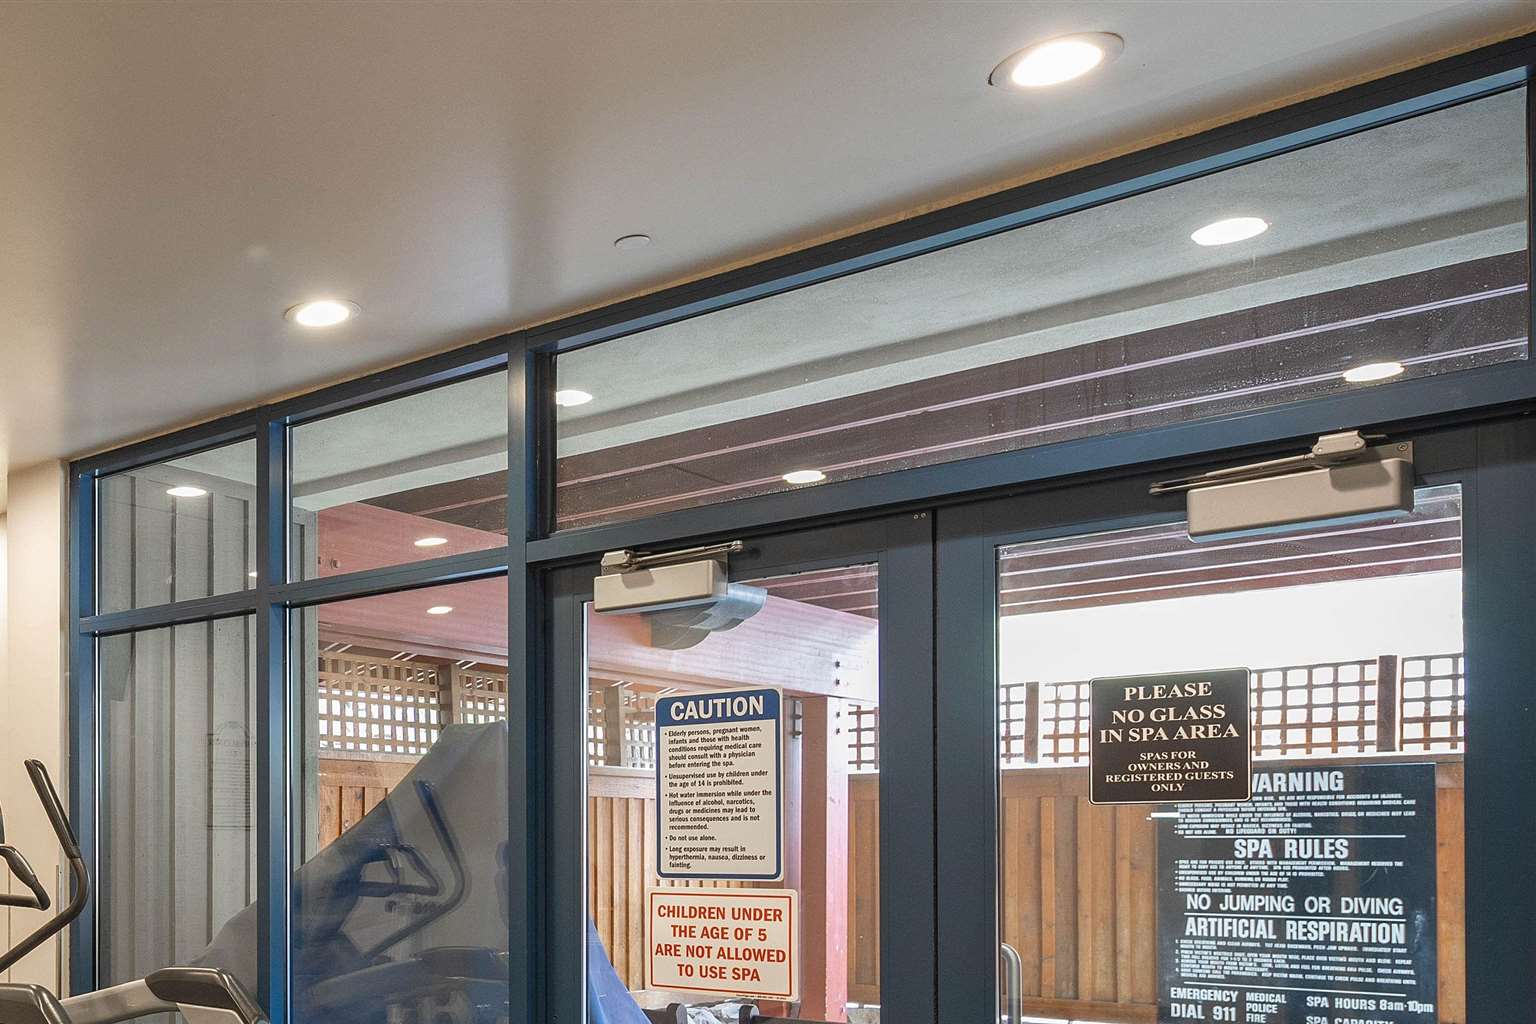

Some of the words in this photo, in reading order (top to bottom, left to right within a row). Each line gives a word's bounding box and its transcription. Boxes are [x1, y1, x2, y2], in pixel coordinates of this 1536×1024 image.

[1124, 683, 1212, 701] PLEASE
[670, 696, 763, 721] CAUTION
[1112, 709, 1144, 724] NO
[1150, 705, 1226, 722] GLASS
[668, 729, 686, 737] Elderly
[713, 726, 738, 735] pregnant
[1099, 729, 1122, 744] IN
[1129, 727, 1167, 742] SPA
[1173, 723, 1240, 740] AREA
[668, 744, 697, 752] conditions
[698, 743, 723, 752] requiring
[728, 750, 755, 759] physician
[1140, 752, 1168, 761] SPAS
[1171, 751, 1196, 759] FOR
[687, 760, 711, 769] entering
[1128, 762, 1181, 772] OWNERS
[1183, 761, 1209, 770] AND
[668, 771, 705, 781] Unsupervised
[718, 771, 725, 779] by
[1105, 773, 1182, 783] REGISTERED
[1185, 771, 1234, 780] GUESTS
[713, 778, 743, 787] prohibited.
[1151, 783, 1185, 792] ONLY
[703, 798, 725, 806] alcohol,
[669, 807, 684, 816] drugs
[669, 845, 682, 853] Long
[1234, 839, 1272, 858] SPA
[1285, 839, 1349, 858] RULES
[669, 853, 707, 862] hyperthermia,
[669, 861, 691, 869] fainting.
[1186, 894, 1211, 911] NO
[1220, 894, 1295, 913] JUMPING
[1305, 897, 1331, 914] OR
[1341, 898, 1403, 916] DIVING
[657, 905, 725, 920] CHILDREN
[732, 907, 783, 921] UNDER
[671, 924, 696, 938] THE
[701, 926, 729, 940] AGE
[734, 927, 753, 941] OF
[758, 929, 767, 942] 5
[1185, 916, 1276, 939] ARTIFICIAL
[1286, 920, 1405, 944] RESPIRATION
[655, 943, 681, 957] ARE
[686, 945, 712, 959] NOT
[717, 946, 786, 963] ALLOWED
[677, 963, 693, 977] TO
[699, 965, 727, 979] USE
[732, 967, 760, 981] SPA
[1170, 987, 1238, 1002] EMERGENCY
[1246, 991, 1287, 1004] MEDICAL
[1246, 1003, 1278, 1013] POLICE
[1306, 997, 1329, 1008] SPA
[1335, 998, 1376, 1010] HOURS
[1170, 1004, 1204, 1019] DIAL
[1213, 1006, 1236, 1022] 911
[1246, 1013, 1266, 1023] FIRE
